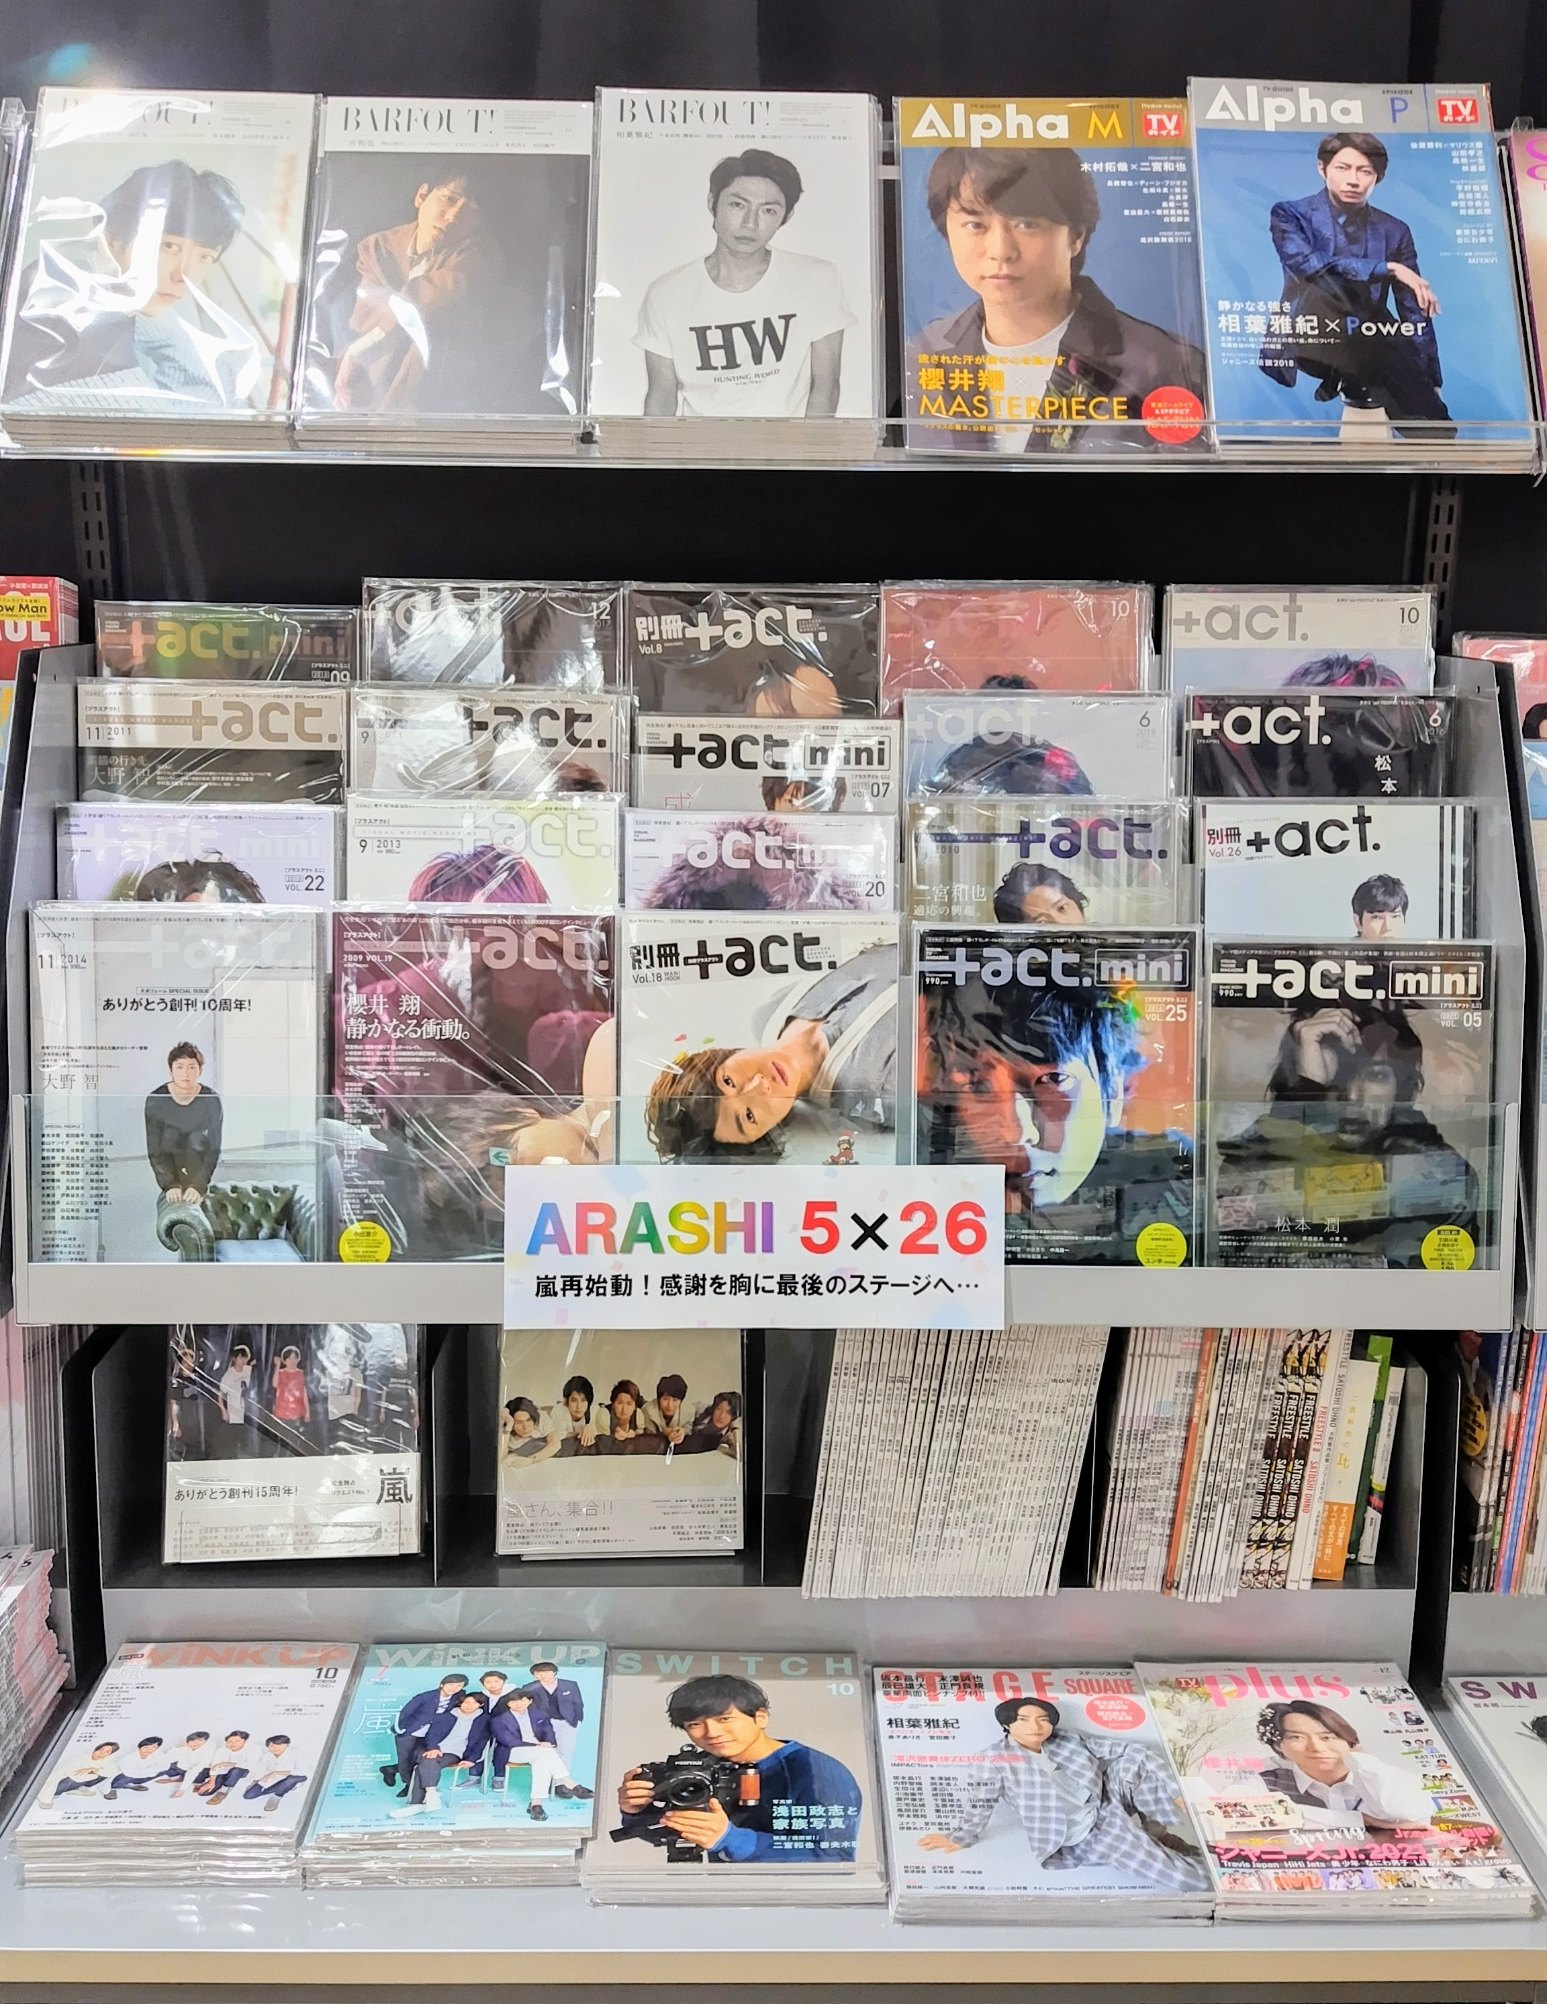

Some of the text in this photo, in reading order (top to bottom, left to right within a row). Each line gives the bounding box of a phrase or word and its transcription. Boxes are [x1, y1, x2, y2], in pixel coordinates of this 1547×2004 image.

[619, 98, 771, 126] BARFOUT!
[1205, 84, 1364, 131] Alpha
[1389, 97, 1409, 123] P
[1441, 100, 1474, 116] TV
[344, 107, 496, 134] BARFOUT!
[911, 102, 1124, 148] Alpha M
[1146, 114, 1179, 130] TV
[1218, 300, 1291, 313] 静かなる強さ
[1217, 314, 1427, 336] 相葉雅紀 Power
[689, 314, 797, 371] HW
[714, 373, 752, 383] HUNTING
[754, 368, 780, 379] WORLD
[918, 367, 1005, 392] 櫻井翔
[919, 395, 1129, 420] MASTERPIECE
[18, 602, 48, 613] Man
[590, 602, 611, 620] 12
[1111, 600, 1130, 617] 10
[1399, 607, 1420, 624] 10
[1173, 593, 1309, 641] +act.
[635, 605, 828, 651] 別冊 +act.
[639, 644, 663, 655] Vol.8
[85, 700, 338, 743] +act.
[1139, 711, 1151, 727] 6
[1190, 695, 1332, 745] +act.
[1429, 709, 1441, 727] 6
[87, 727, 132, 740] 11 2011
[361, 732, 369, 743] 9
[89, 767, 125, 785] 大野
[871, 783, 890, 798] 07
[1207, 805, 1380, 857] 別冊 +act.
[359, 839, 402, 854] 9 2013
[1209, 847, 1242, 858] Vol.26
[304, 875, 325, 891] 22
[864, 881, 885, 897] 20
[914, 884, 987, 902] 二宮和也
[38, 954, 87, 969] 11 2014
[343, 954, 393, 963] 2009 VOL.19
[629, 932, 837, 980] 別冊 +act.
[919, 947, 1183, 987] +act. mini
[632, 972, 663, 984] Vol.18
[1211, 959, 1478, 1000] +act. mini
[346, 994, 421, 1015] 櫻井 翔
[1165, 1005, 1188, 1022] 25
[346, 1018, 470, 1040] 静かなる衝動。
[1463, 1012, 1482, 1028] 05
[43, 1073, 98, 1090] 大野 智
[525, 1200, 988, 1256] ARASHI 5×26
[1274, 1216, 1311, 1232] 松本
[534, 1272, 980, 1299] 嵐再始動！感謝を胸に最後のステージへ…
[1252, 1391, 1282, 1520] FREESTYLE SATOSHI OHNO
[1267, 1391, 1300, 1518] FREESTYLE SATOSHI OHNO
[1284, 1392, 1316, 1518] FREESTYLE SATOSHI OHNO
[1302, 1406, 1327, 1514] FREESTYLE SATOSHI OHNO
[376, 1467, 413, 1505] 嵐
[529, 1644, 600, 1667] UP
[614, 1652, 857, 1677] SWITCH
[315, 1667, 339, 1680] 10
[827, 1683, 855, 1696] 10
[881, 1670, 1139, 1703] STAGE SQUARE
[1204, 1666, 1352, 1709] plus
[352, 1704, 407, 1734] 嵐
[886, 1717, 961, 1729] 相葉雅紀
[772, 1805, 858, 1817] 浅田政志と
[772, 1818, 846, 1830] 家族写真
[1289, 1825, 1366, 1850] Spring
[1369, 1842, 1428, 1861] 2021
[1221, 1860, 1249, 1869] Travis
[1252, 1861, 1279, 1869] Japan
[1284, 1860, 1304, 1868] HiHi
[1307, 1860, 1326, 1868] Jets
